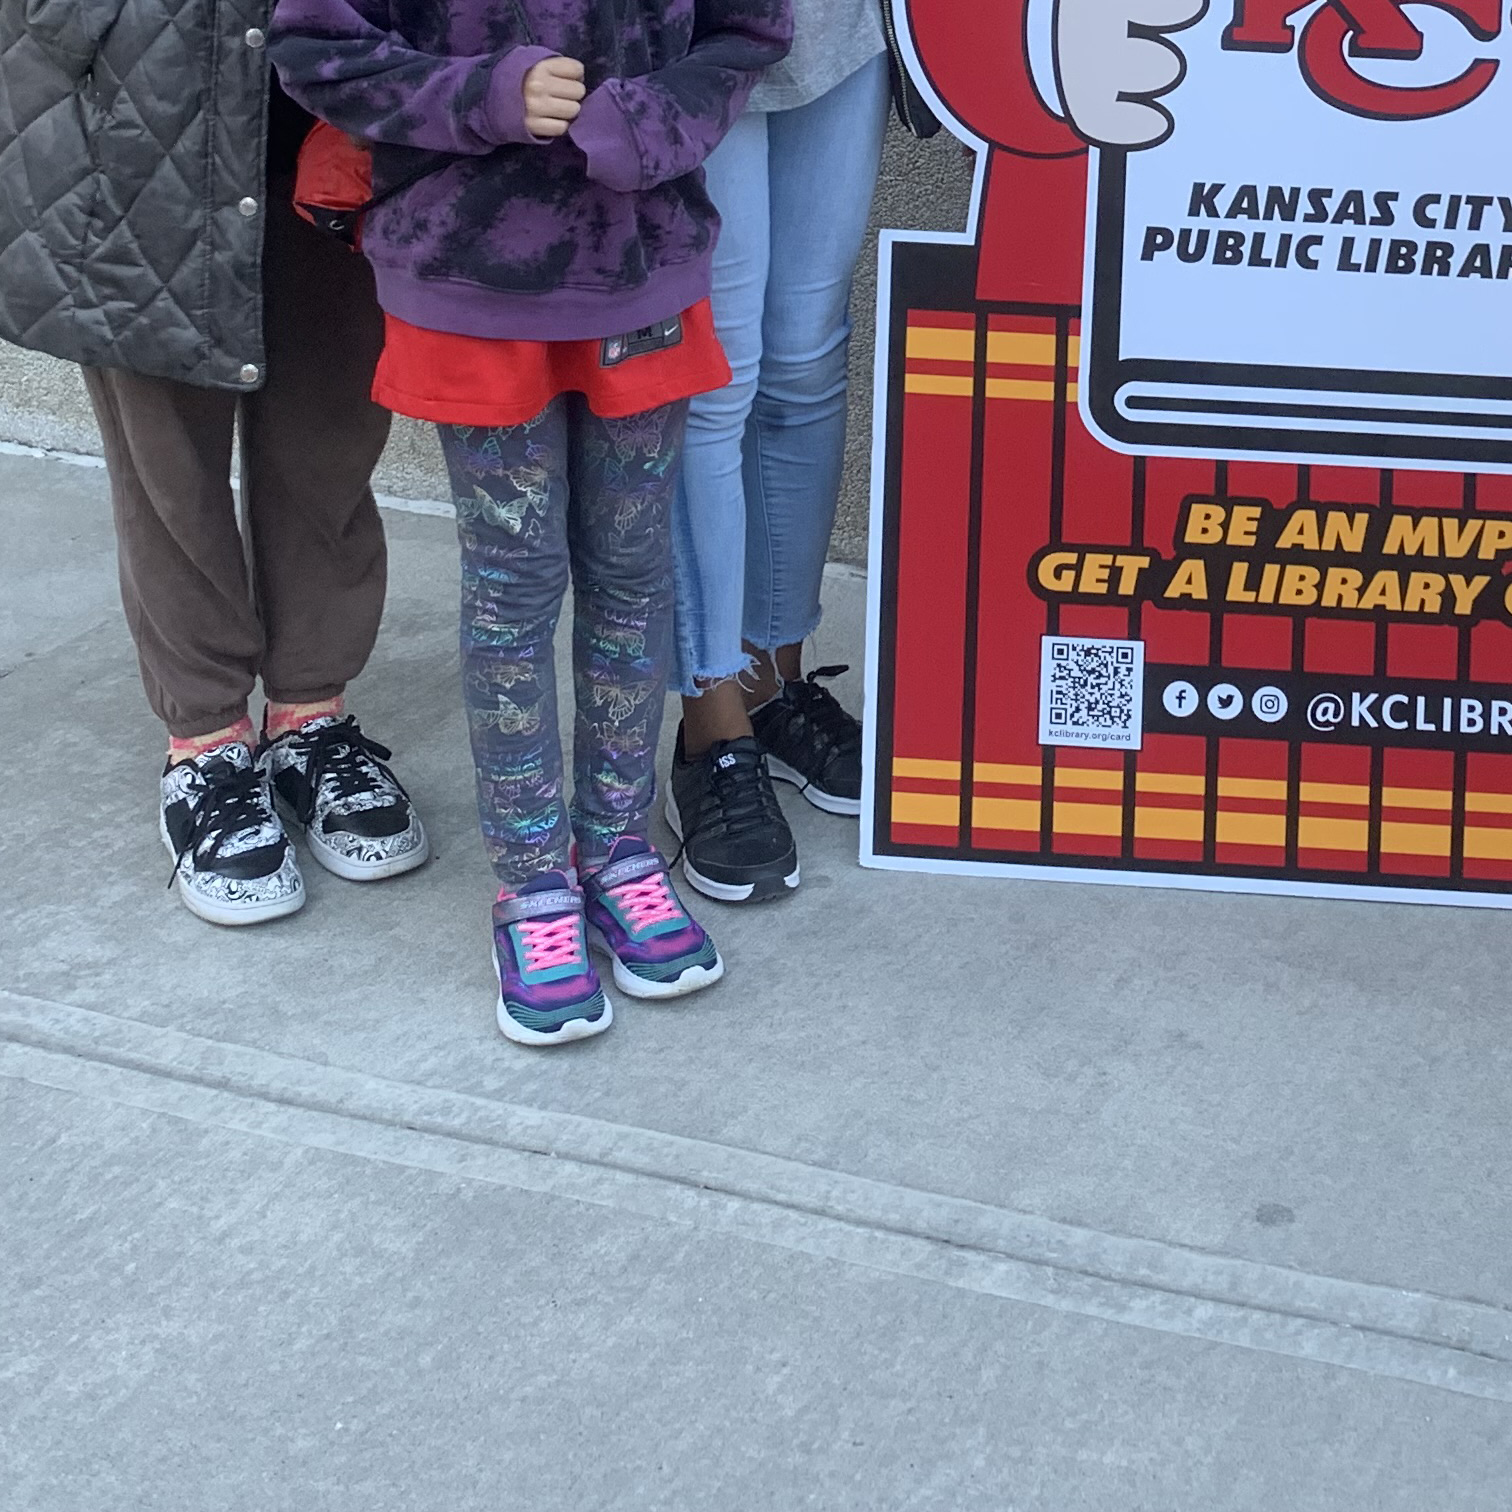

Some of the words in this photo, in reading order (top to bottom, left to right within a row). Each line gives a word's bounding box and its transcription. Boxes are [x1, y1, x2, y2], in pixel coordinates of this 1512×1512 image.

[1187, 181, 1398, 227] KANSAS
[1140, 225, 1323, 270] PUBLIC
[1184, 502, 1262, 546] BE
[1275, 509, 1370, 553] AN
[1037, 552, 1150, 595] GET
[1163, 560, 1208, 601] A
[1225, 561, 1492, 617] LIBRARY
[1048, 729, 1131, 742] kclibrary.org/card
[600, 856, 662, 882] SKECHERS
[519, 895, 583, 911] SKECHERS
